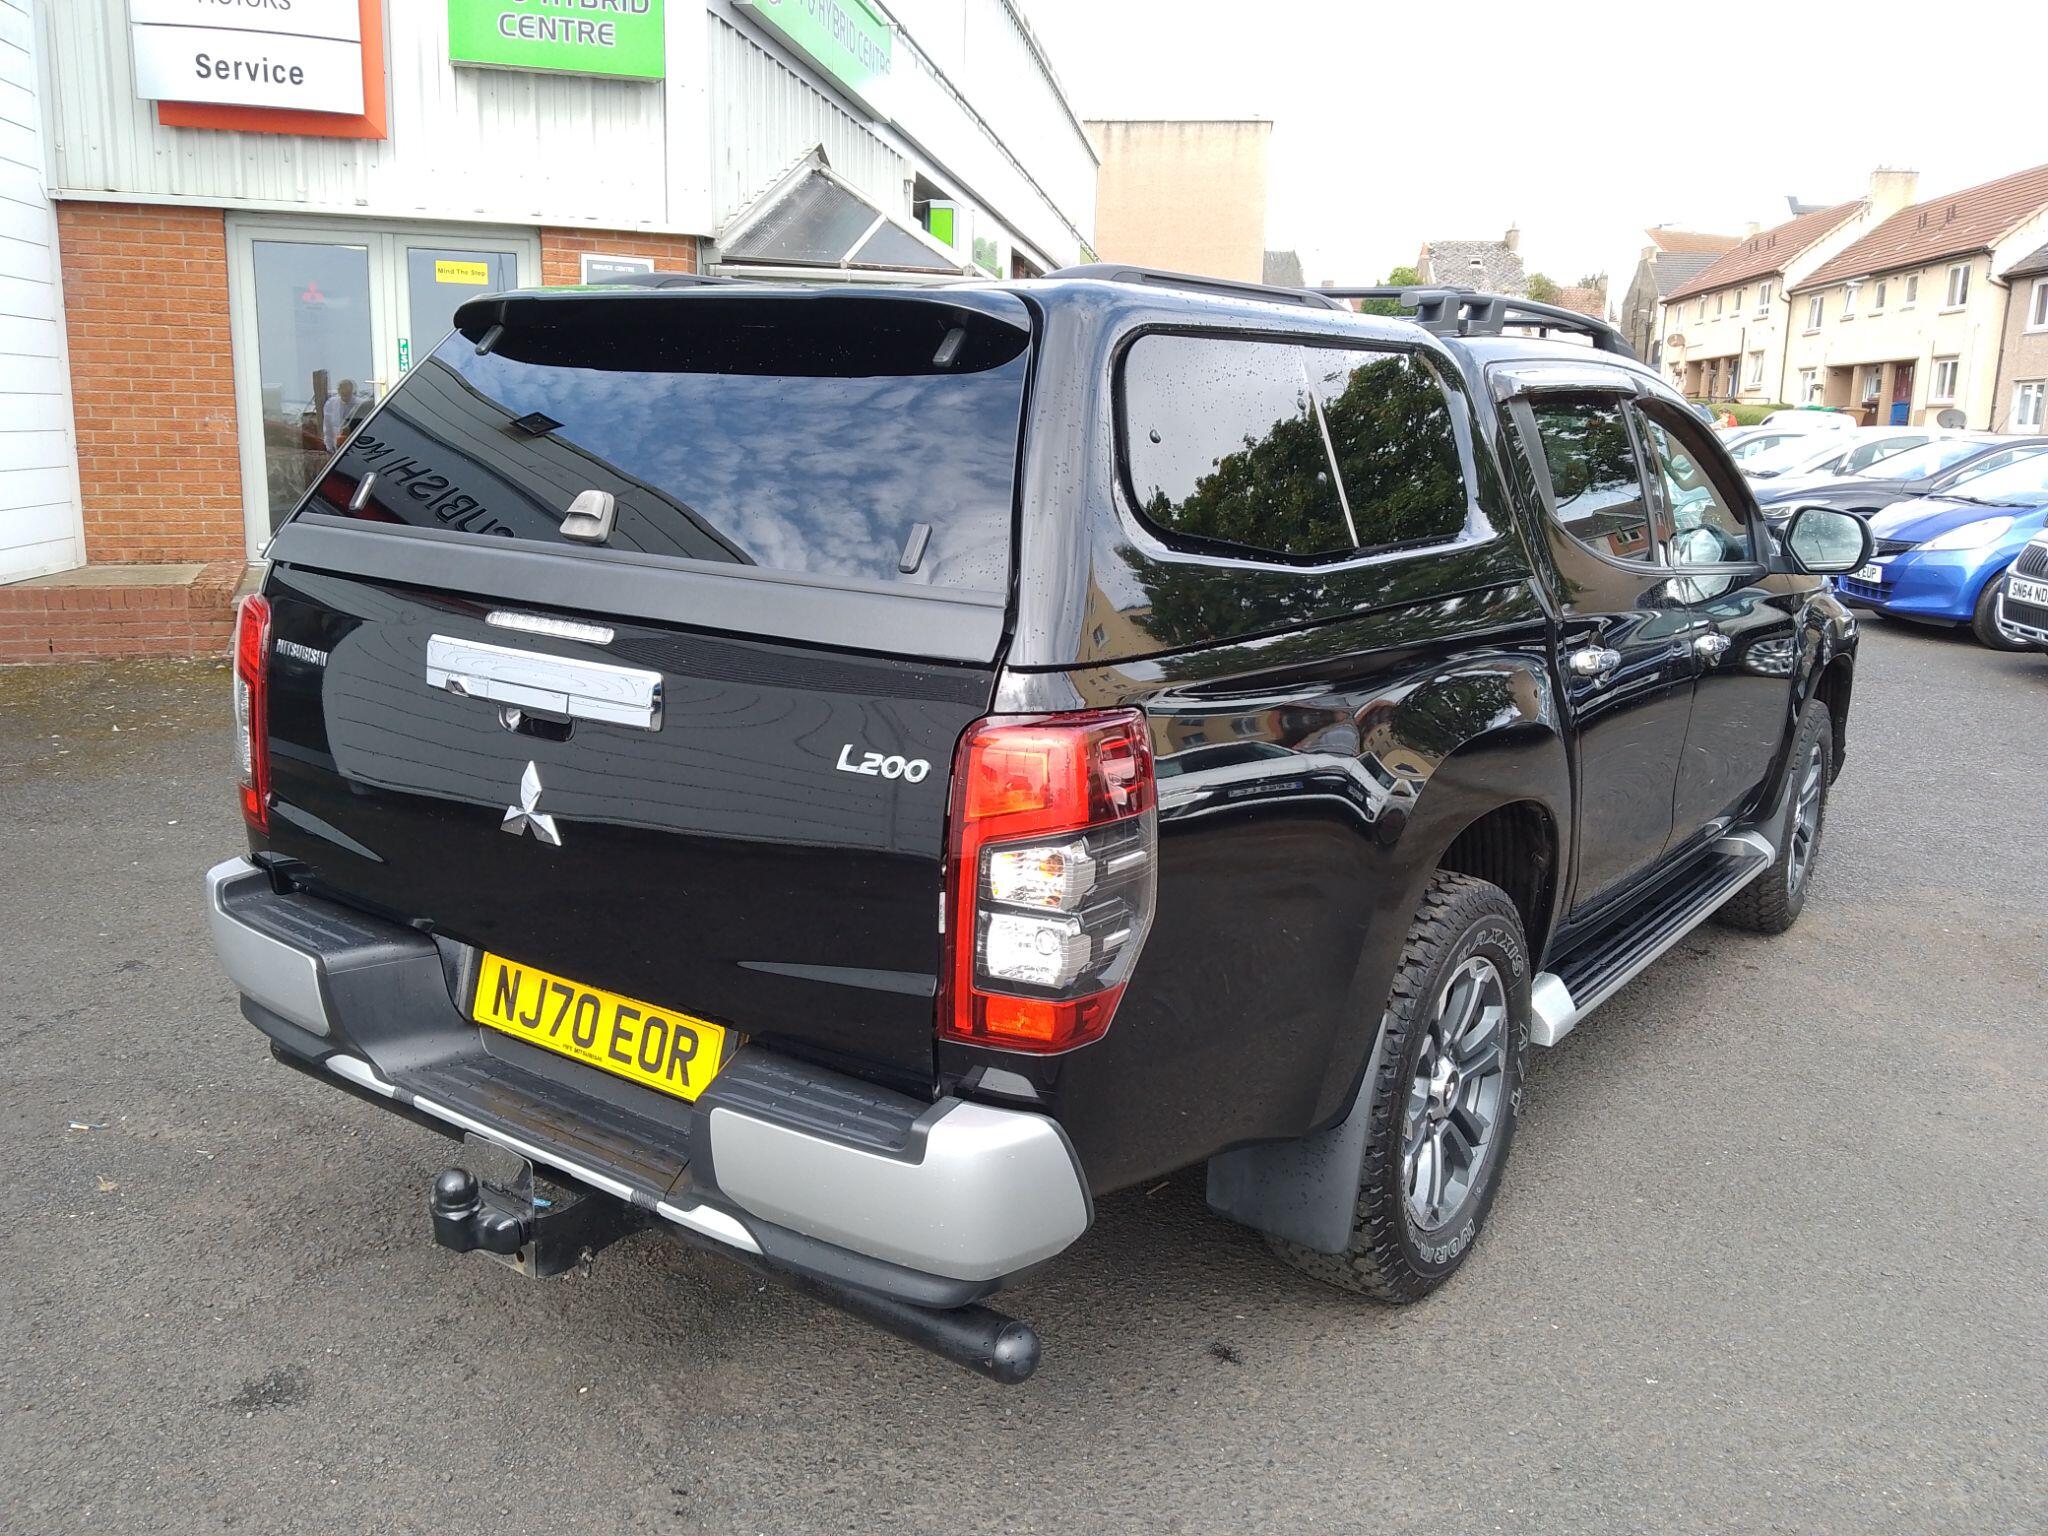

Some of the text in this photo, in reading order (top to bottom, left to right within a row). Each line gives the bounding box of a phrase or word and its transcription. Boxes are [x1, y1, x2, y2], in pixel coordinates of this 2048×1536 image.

[500, 14, 615, 46] CENTRE
[195, 53, 304, 85] Service
[437, 267, 455, 275] Mind
[399, 339, 409, 372] PUSH
[2011, 582, 2048, 603] SN64 ND
[276, 638, 328, 667] MITSUBISHI
[836, 744, 932, 783] L200
[492, 964, 699, 1087] NJ70 EOR
